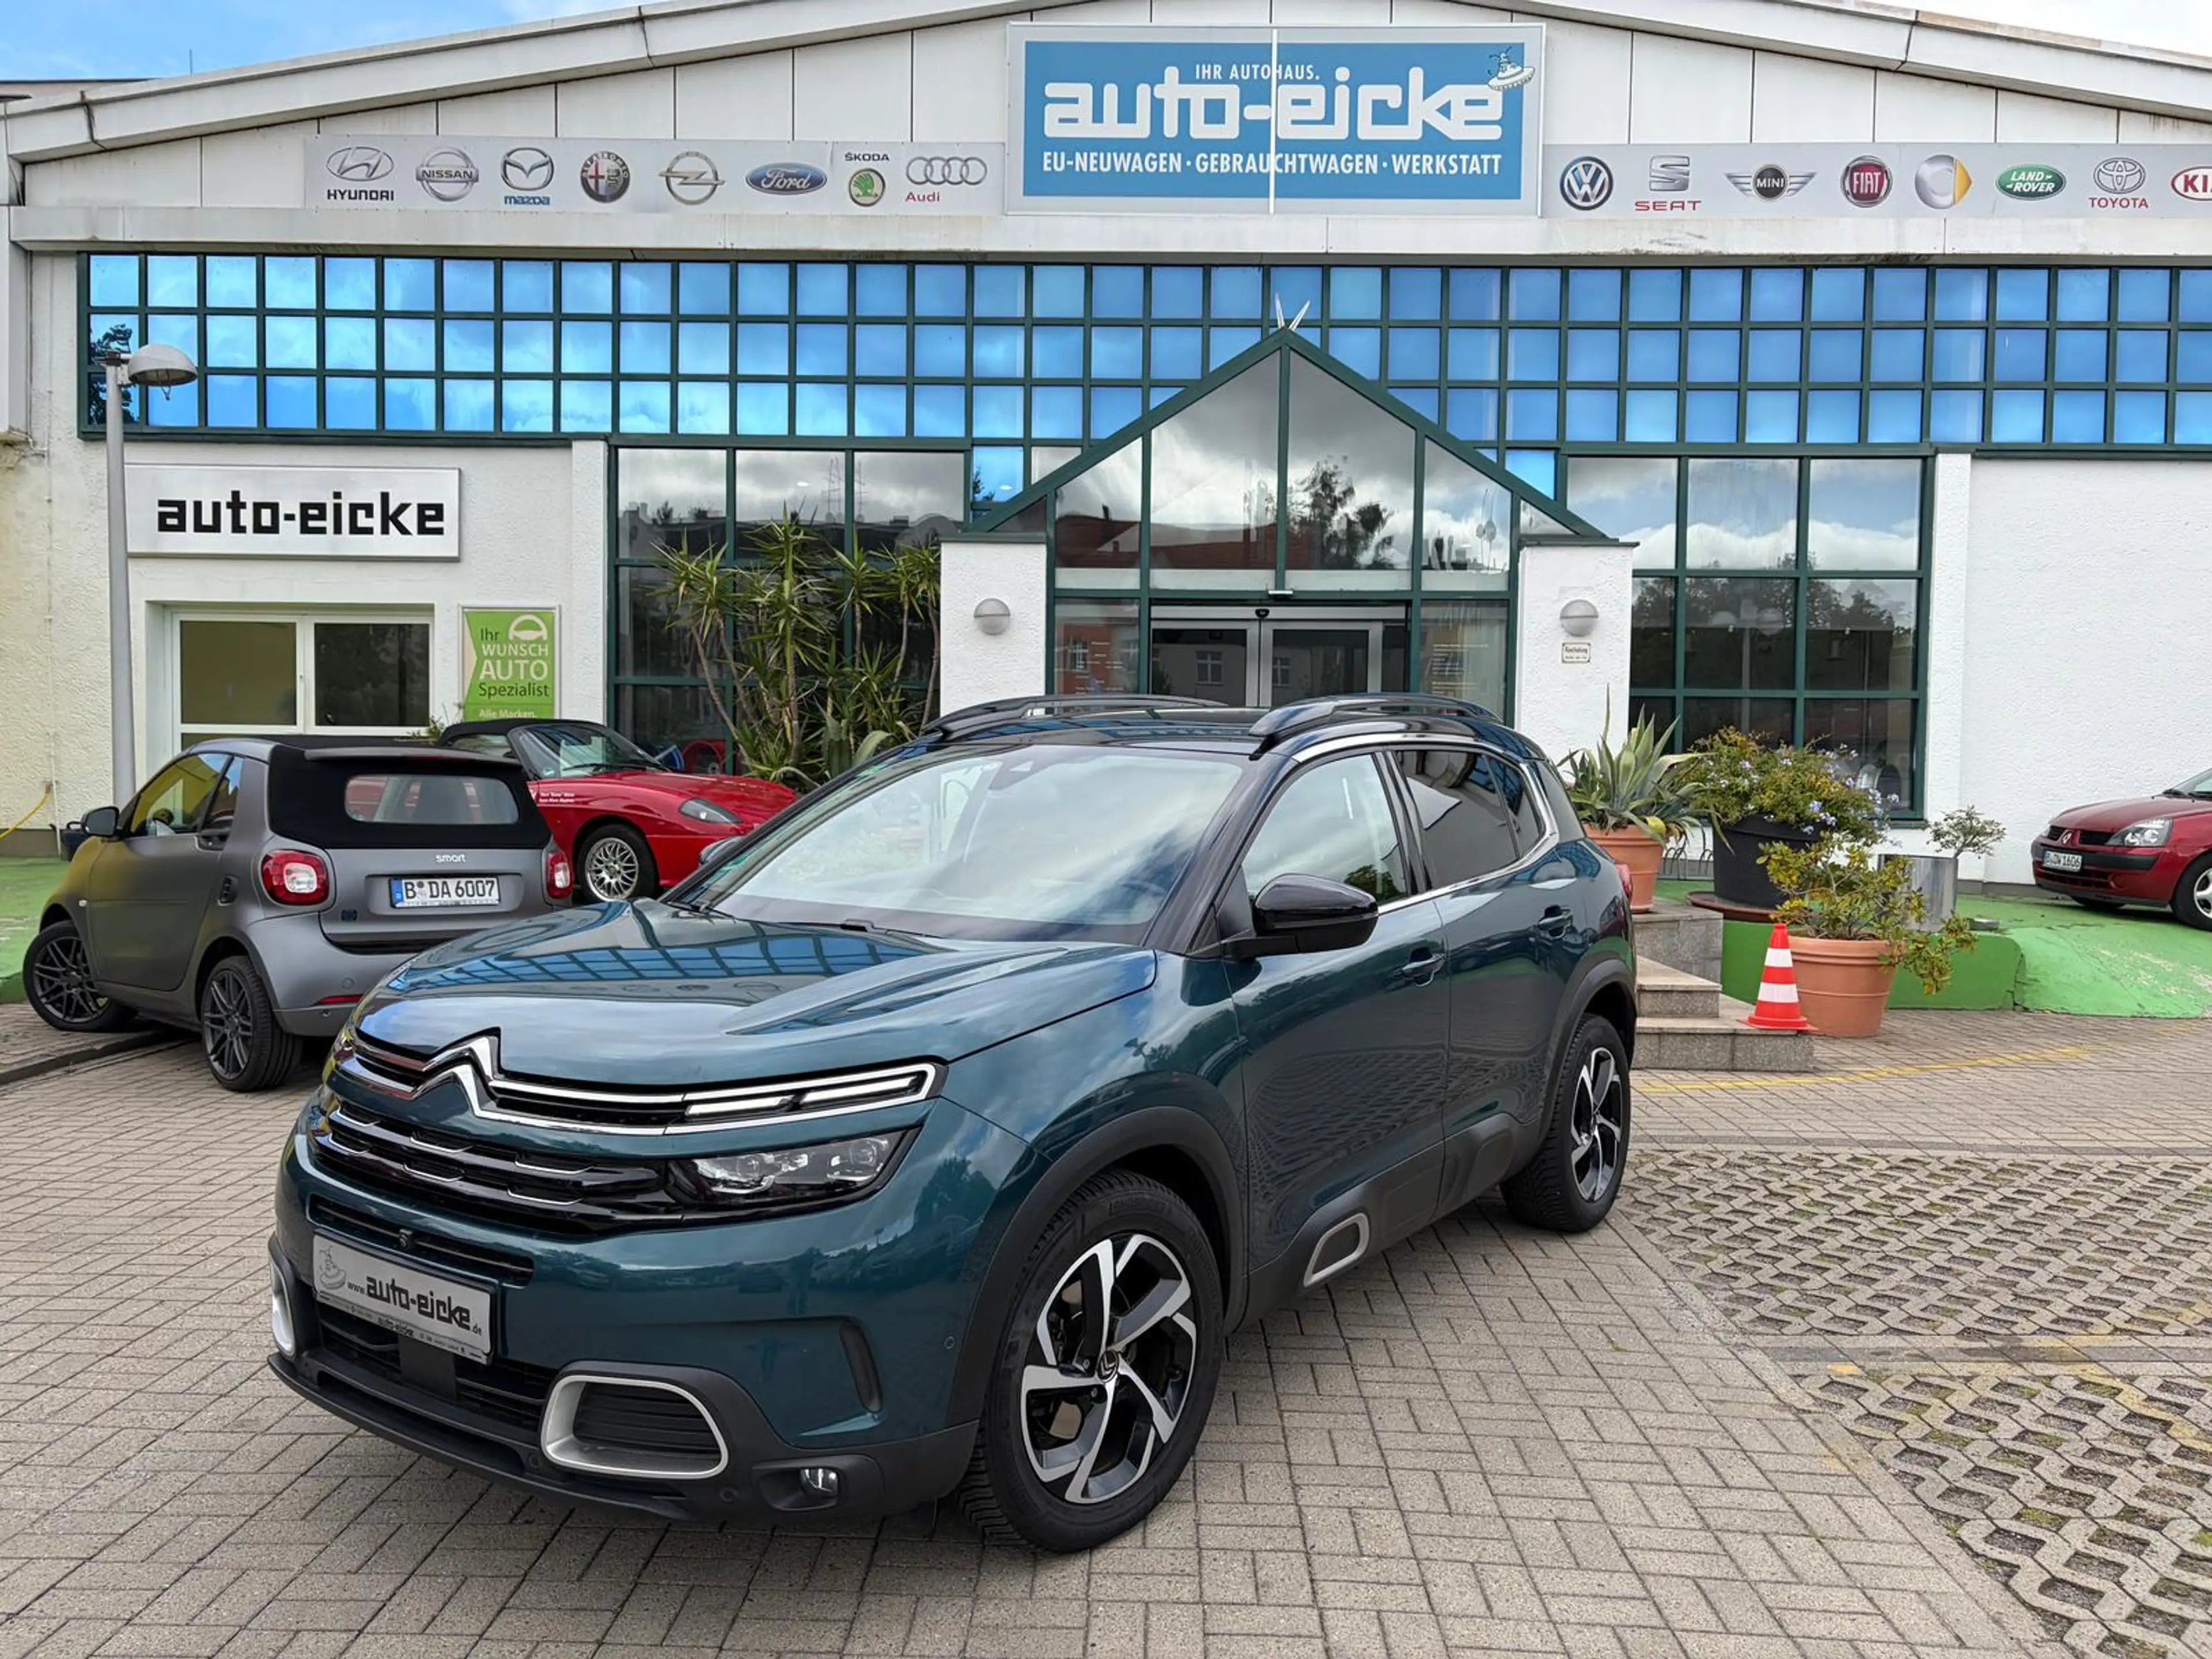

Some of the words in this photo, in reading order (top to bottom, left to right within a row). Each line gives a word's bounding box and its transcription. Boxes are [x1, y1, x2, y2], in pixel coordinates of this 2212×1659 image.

[1196, 65, 1222, 79] IHR
[1229, 65, 1320, 80] AUTOHAUS.
[1044, 66, 1502, 141] auto-eicke
[844, 151, 889, 161] ŠKODA
[1043, 152, 1182, 173] EU-NEUWAGEN
[1195, 153, 1378, 174] GEBRAUCHTWAGEN
[1392, 154, 1502, 175] WERKSTATT
[422, 169, 472, 179] NISSAN
[761, 167, 810, 189] Ford
[2010, 171, 2044, 181] LAND
[1757, 177, 1785, 188] MINI
[1853, 171, 1881, 194] FIAT
[2013, 182, 2055, 192] ROVER
[2183, 174, 2212, 193] KI
[327, 189, 394, 201] HYUNDAI
[905, 191, 940, 202] Audi
[1635, 200, 1702, 211] SEAT
[2089, 197, 2149, 209] TOYOTA
[157, 490, 444, 536] auto-eicke
[480, 627, 500, 641] Ihr
[482, 643, 548, 657] WUNSCH
[479, 659, 548, 681] AUTO
[478, 682, 551, 699] Spezialist
[435, 853, 466, 863] smart
[405, 881, 416, 899] B
[428, 880, 452, 898] DA
[454, 880, 495, 897] 6007
